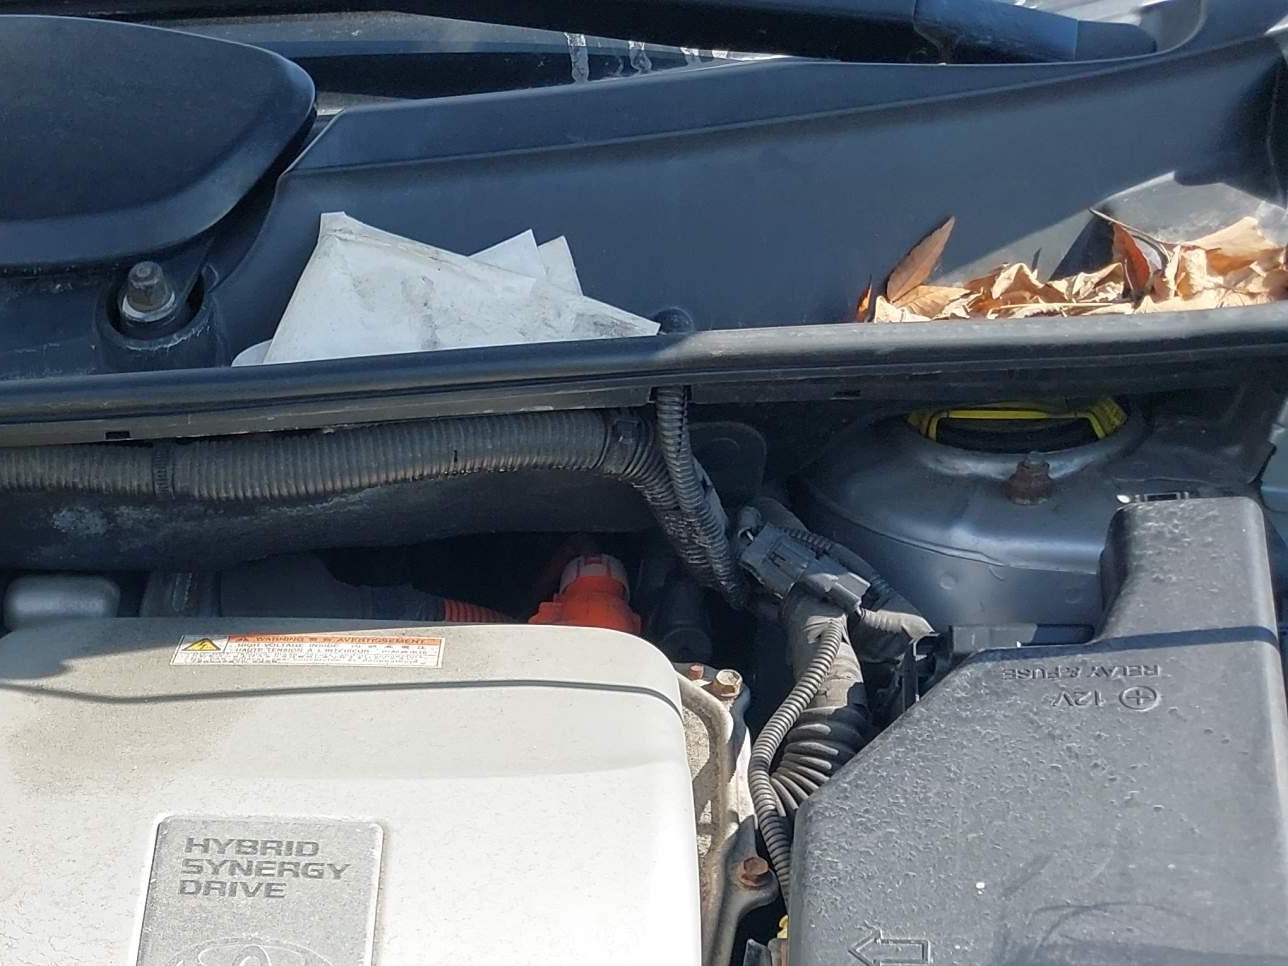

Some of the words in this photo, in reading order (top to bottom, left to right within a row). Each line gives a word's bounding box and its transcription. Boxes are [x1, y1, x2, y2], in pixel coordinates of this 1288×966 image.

[1001, 664, 1062, 681] FUSE
[1088, 664, 1161, 680] RELAY
[1051, 689, 1106, 708] 12V
[184, 837, 320, 857] HYBRID
[181, 858, 351, 880] SYNERGY
[179, 879, 288, 898] DRIVE
